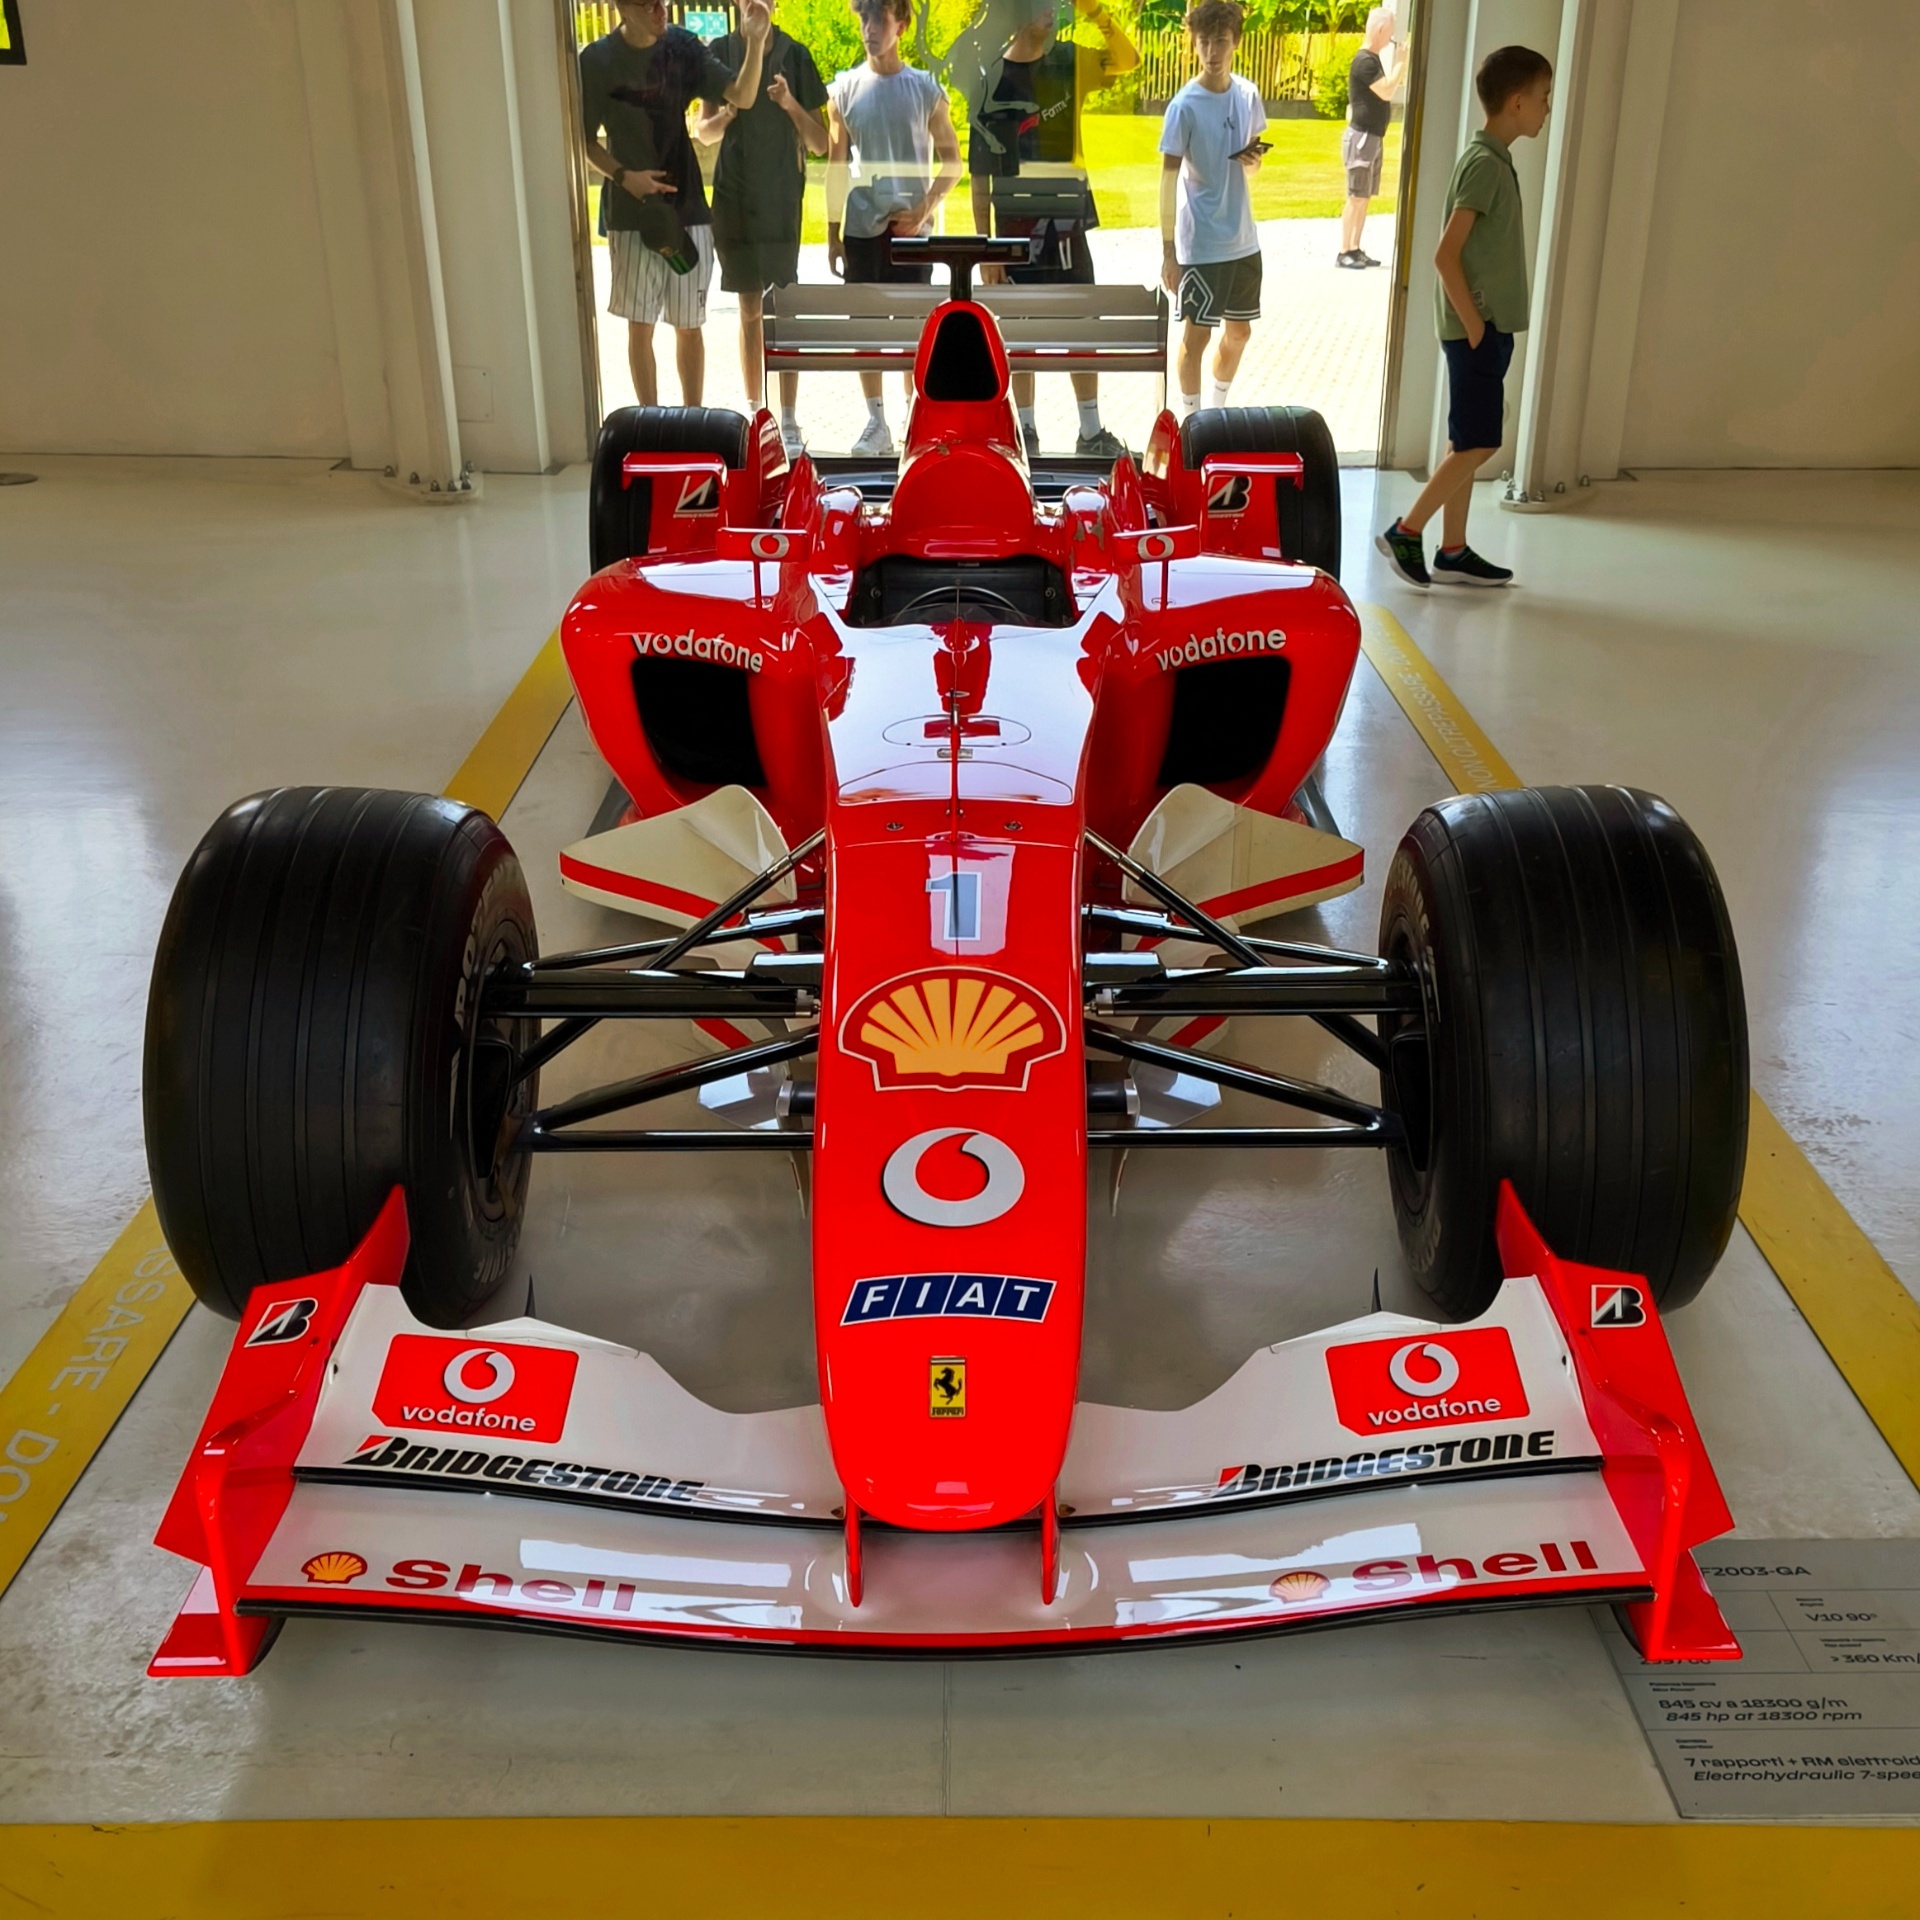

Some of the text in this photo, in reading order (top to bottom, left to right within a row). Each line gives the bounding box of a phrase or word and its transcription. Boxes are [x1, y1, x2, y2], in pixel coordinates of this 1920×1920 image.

[632, 629, 763, 674] vodafone
[1155, 626, 1288, 671] vodafone
[925, 872, 982, 941] 1
[861, 1281, 1040, 1314] FIAT
[402, 1404, 537, 1432] vodafone
[1368, 1397, 1502, 1427] vodafone
[0, 1429, 60, 1523] DO
[342, 1435, 705, 1501] BRIDGESTONE
[1213, 1430, 1556, 1498] BRIDGESTONE
[1352, 1541, 1599, 1590] Shell
[385, 1559, 636, 1612] Shell
[1807, 1613, 1843, 1622] V10
[1843, 1654, 1879, 1663] 360
[1659, 1697, 1848, 1709] 845 cv a 18300 g/m
[1666, 1711, 1862, 1722] 845 hp at 18300 rpm
[1684, 1757, 1697, 1767] 7
[1701, 1756, 1785, 1768] rapporti
[1801, 1757, 1833, 1766] RM
[1694, 1770, 1855, 1782] Electrohydraulic
